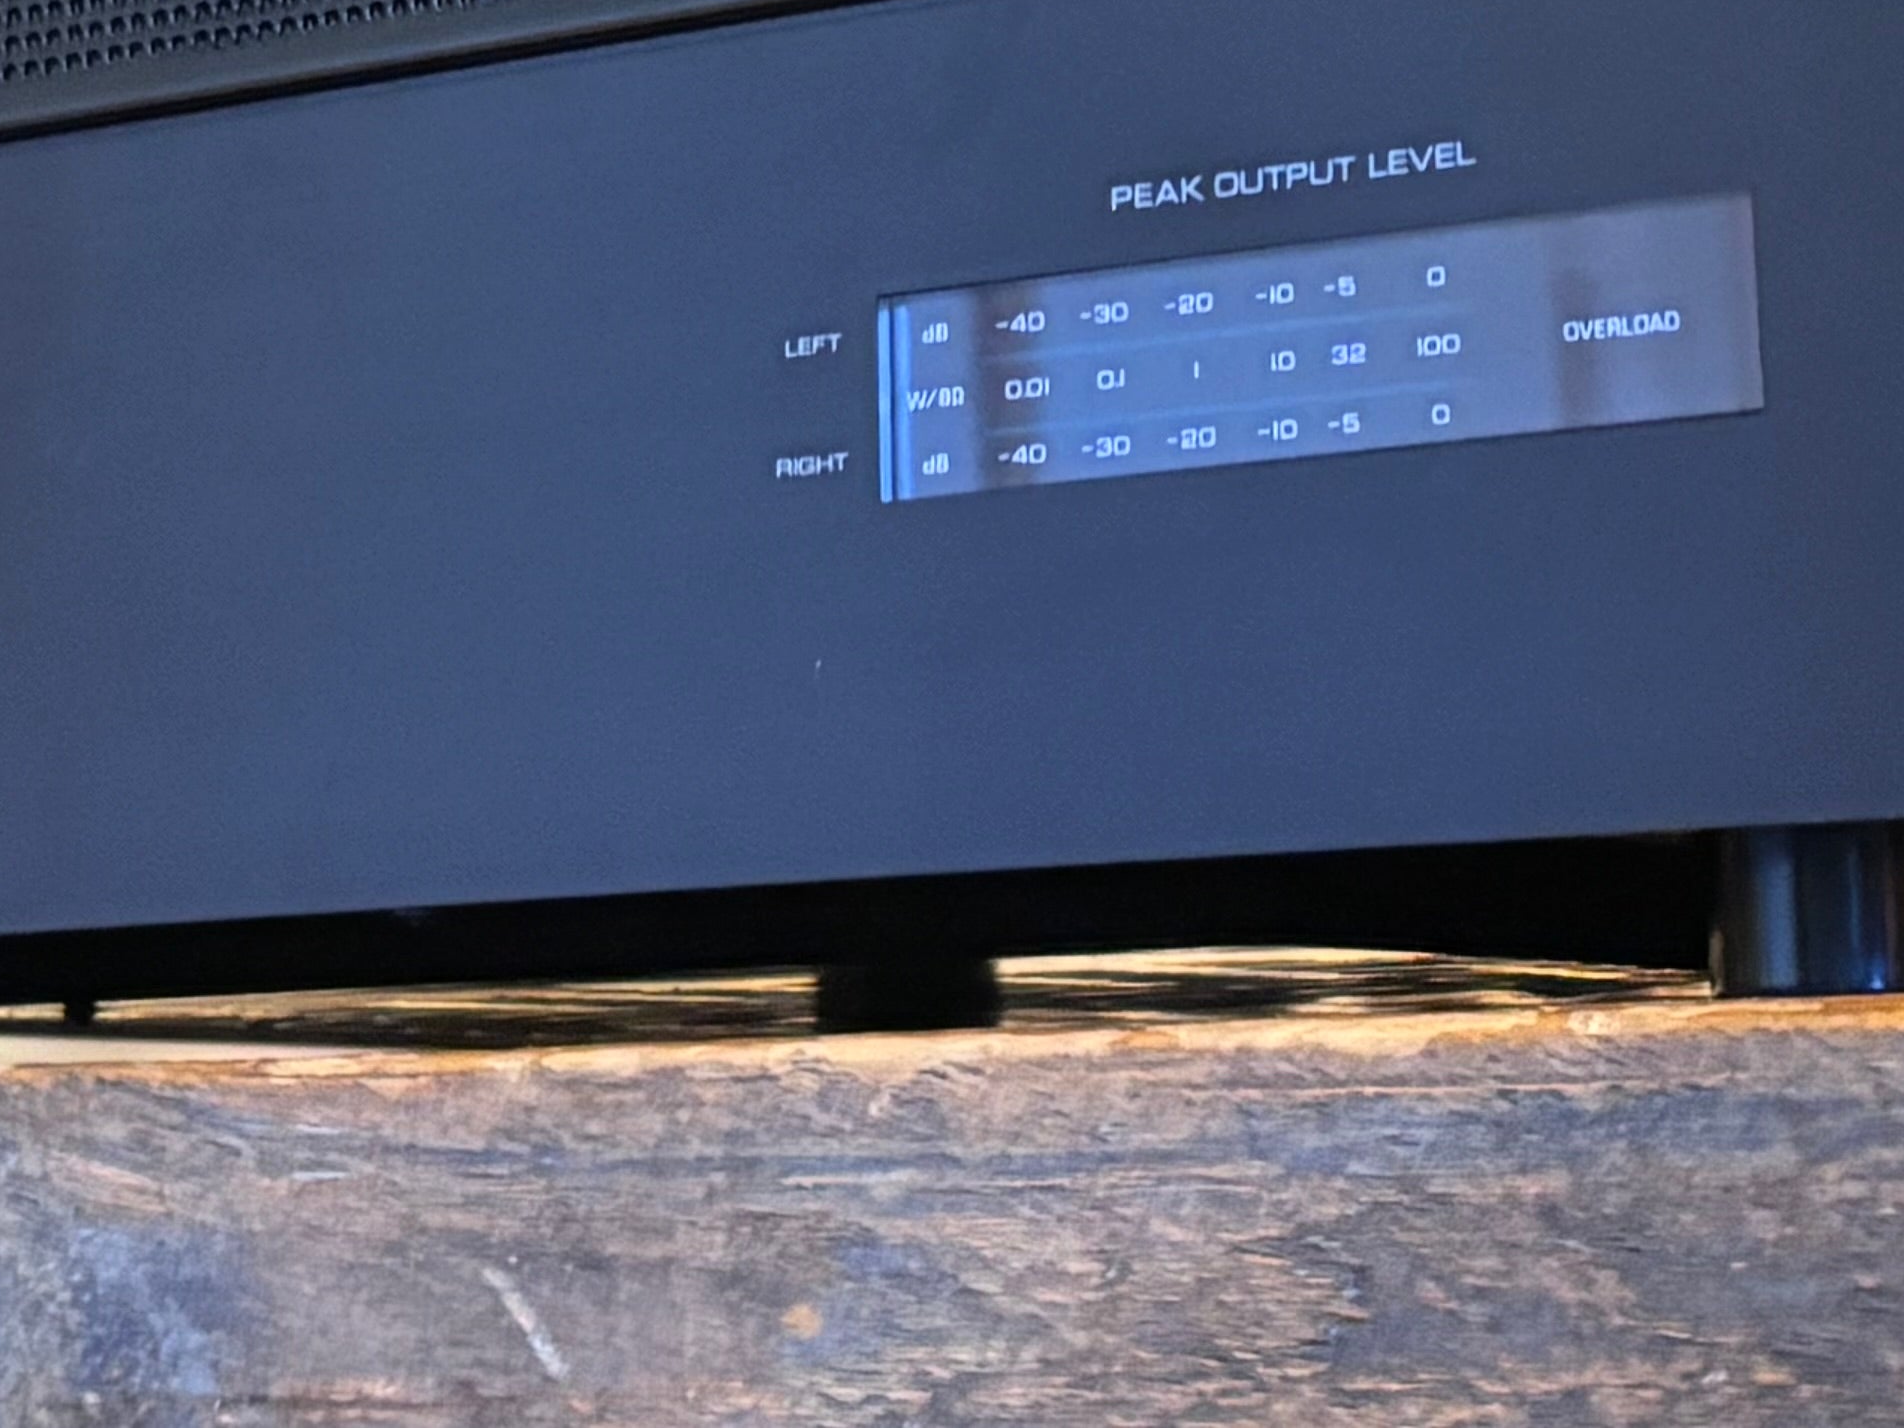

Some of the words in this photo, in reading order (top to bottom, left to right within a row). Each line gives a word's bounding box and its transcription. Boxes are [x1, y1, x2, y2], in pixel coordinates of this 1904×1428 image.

[1111, 176, 1206, 212] PEAK
[1214, 155, 1356, 200] OUTPUT
[1368, 140, 1477, 180] LEVEL
[922, 322, 949, 345] dB
[995, 311, 1046, 334] -40
[1080, 302, 1130, 326] -30
[1165, 291, 1214, 316] -20
[1255, 282, 1295, 305] -10
[1323, 275, 1356, 298] -5
[1426, 265, 1447, 288] 0
[784, 333, 843, 359] LEFT
[1562, 309, 1681, 343] OVERLOAD
[1270, 350, 1296, 373] 10
[1331, 341, 1366, 366] 32
[1416, 333, 1462, 357] 100
[922, 453, 949, 475] dB
[998, 443, 1048, 465] -40
[1082, 434, 1132, 458] -30
[1167, 426, 1217, 450] -20
[1258, 418, 1298, 441] -10
[1327, 411, 1361, 434] -5
[1431, 403, 1451, 426] 0
[775, 452, 850, 480] RIGHT
